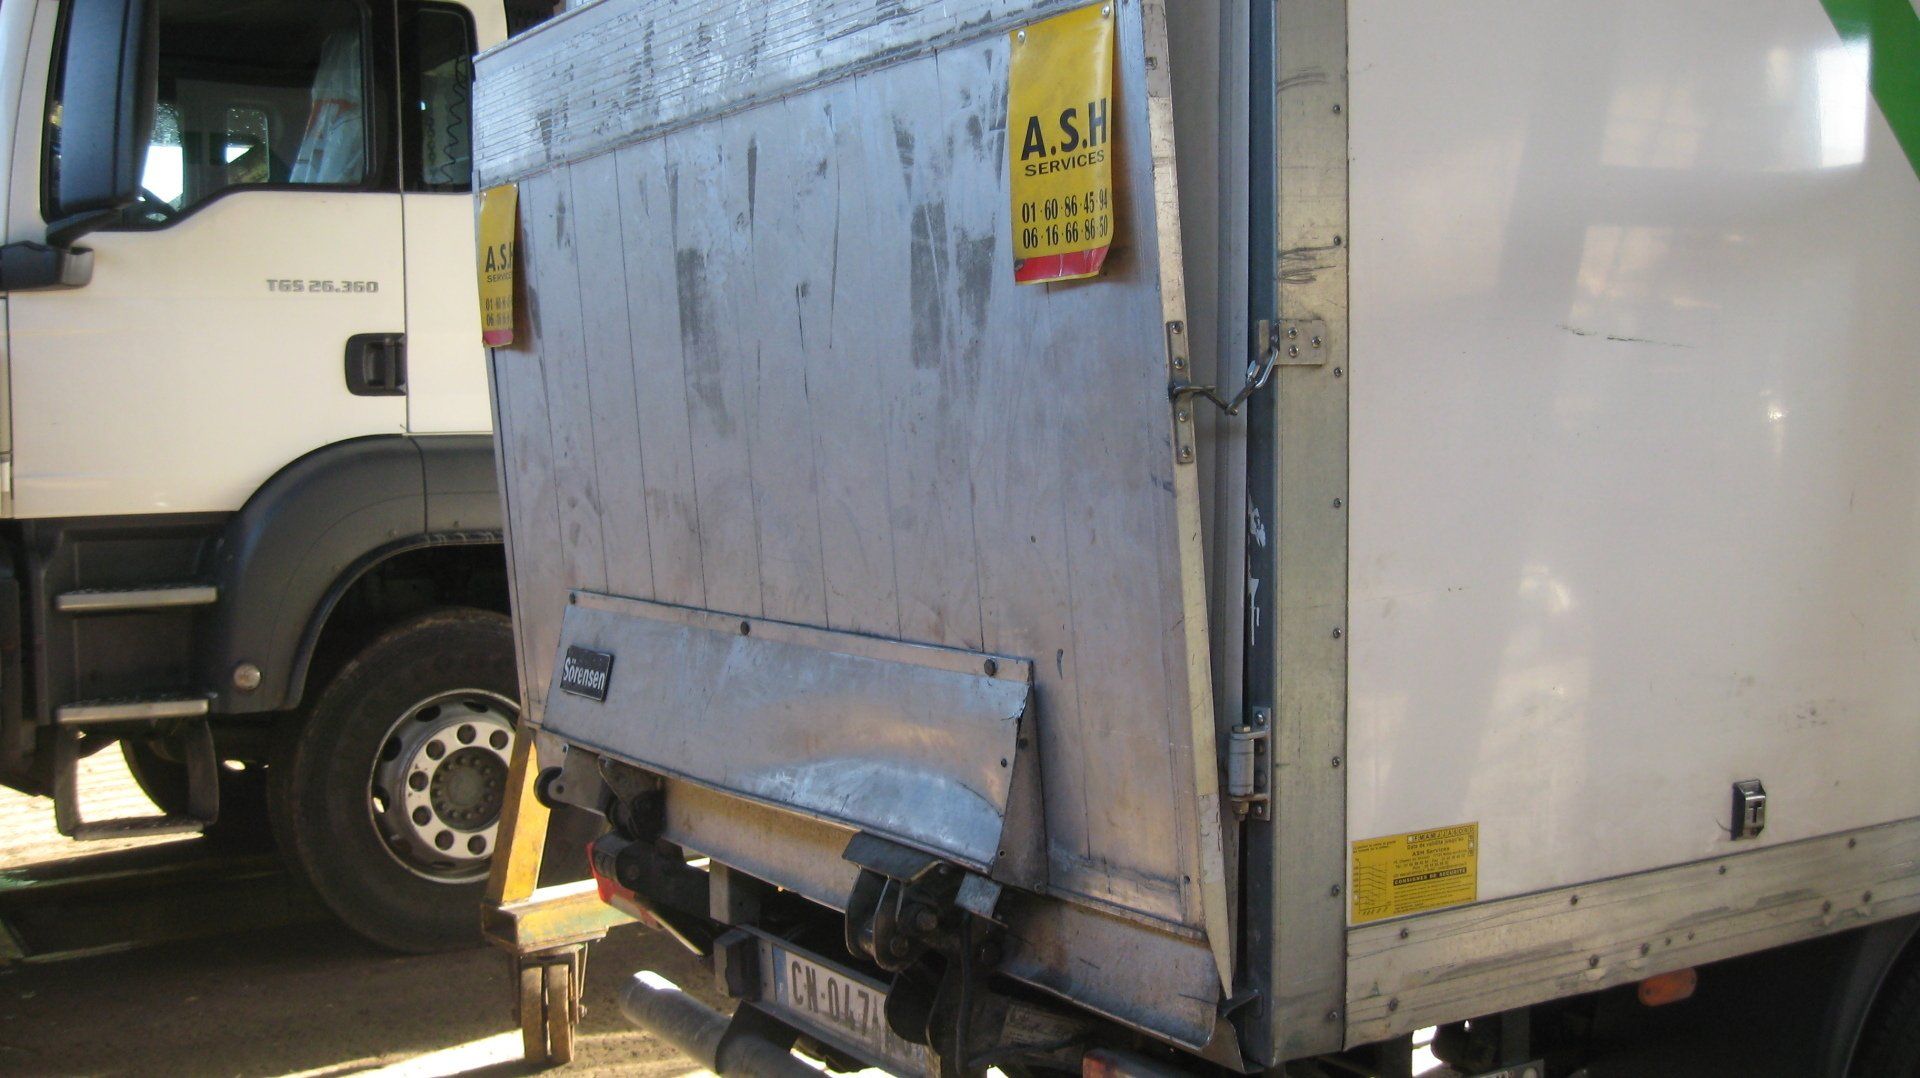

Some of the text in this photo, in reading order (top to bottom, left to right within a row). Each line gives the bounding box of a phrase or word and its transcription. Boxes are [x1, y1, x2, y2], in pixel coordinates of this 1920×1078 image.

[1021, 98, 1107, 161] A.S.H
[1024, 150, 1105, 177] SERVICES
[266, 279, 379, 293] TGS 26.360
[563, 657, 606, 690] Sörensen
